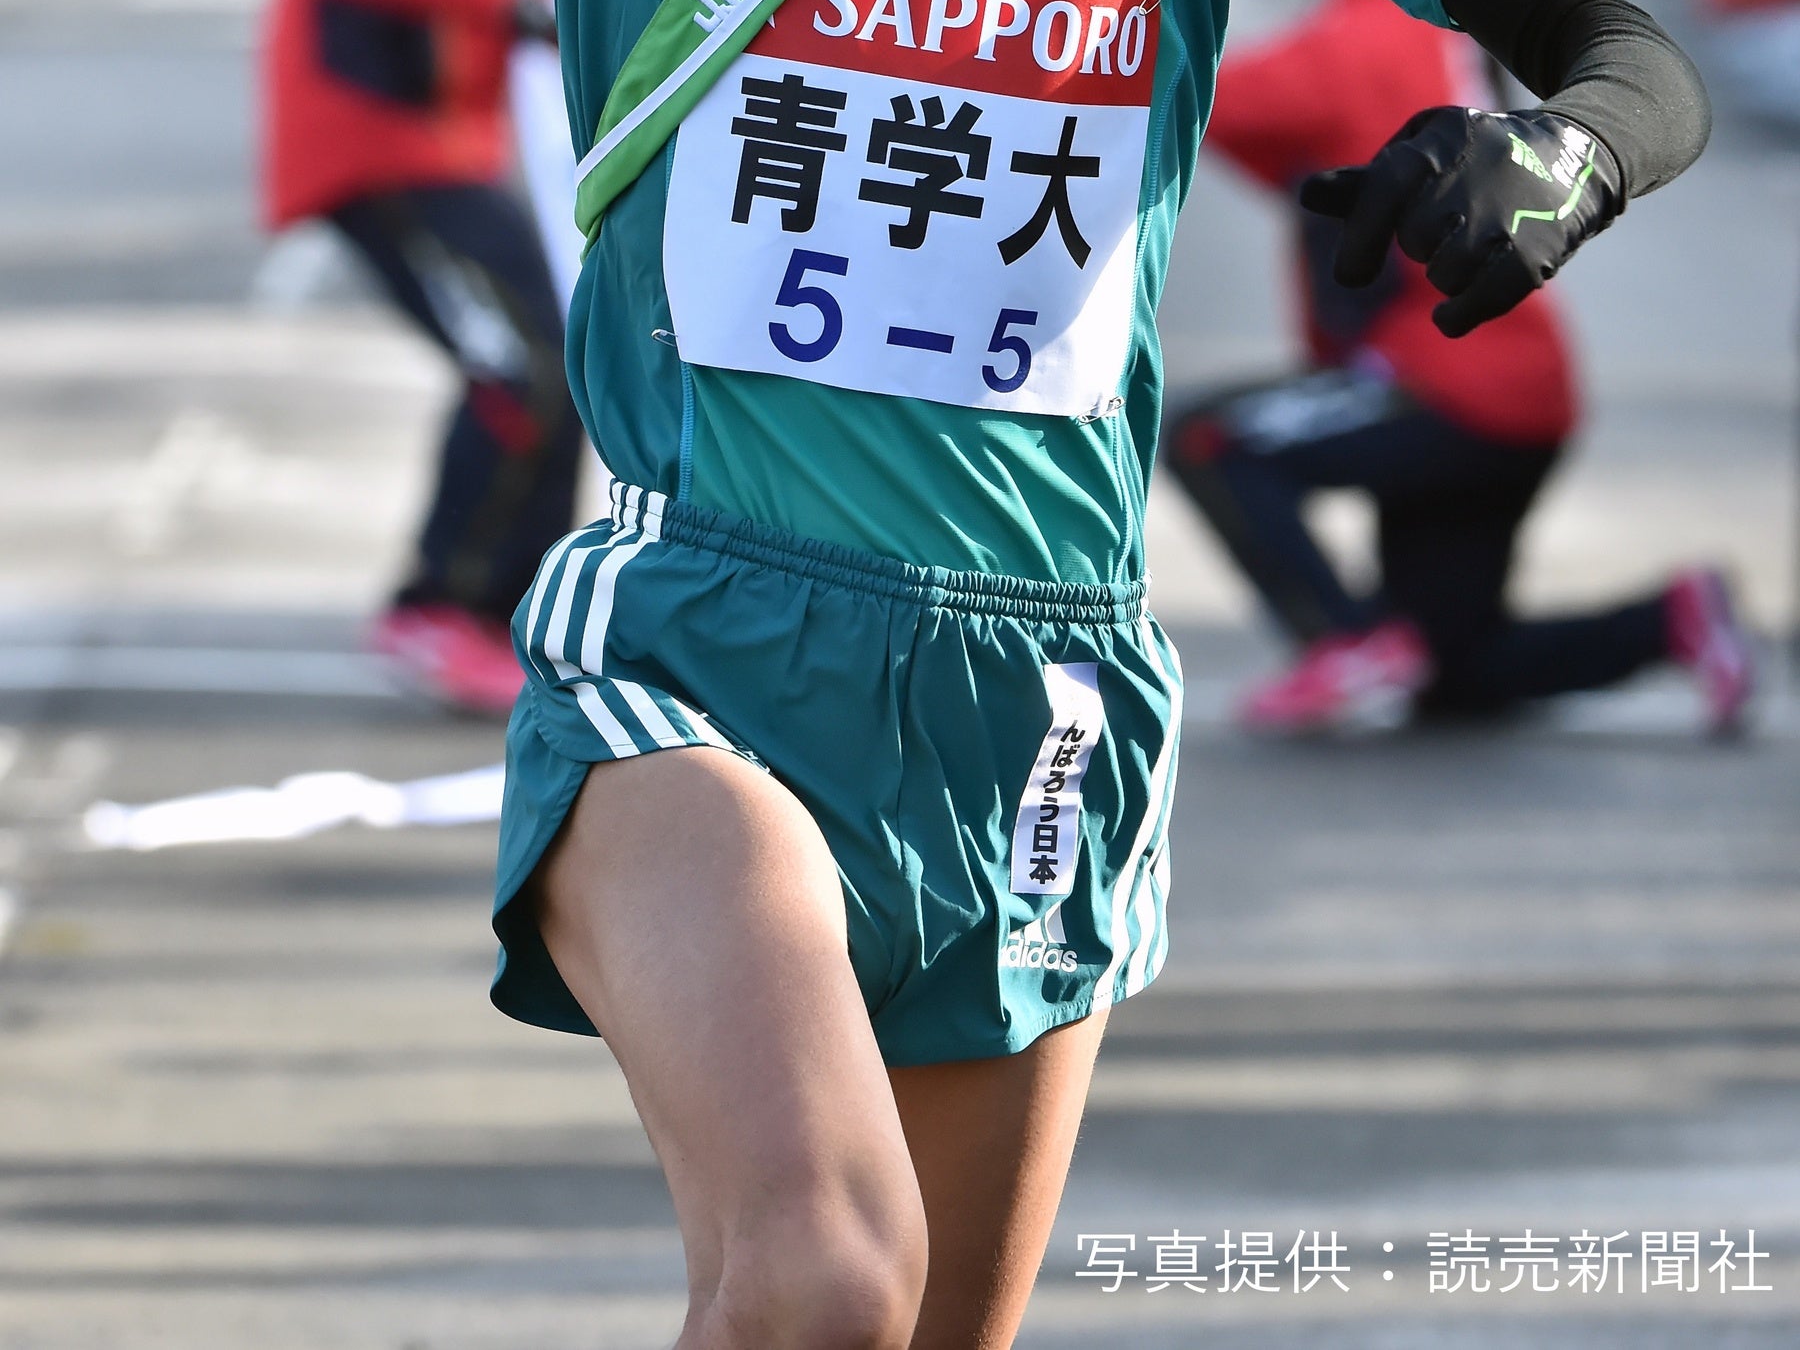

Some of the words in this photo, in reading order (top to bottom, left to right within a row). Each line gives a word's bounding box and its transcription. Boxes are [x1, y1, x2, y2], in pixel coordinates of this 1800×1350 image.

[730, 73, 1101, 270] 青学大
[1029, 692, 1086, 886] んばろう日本
